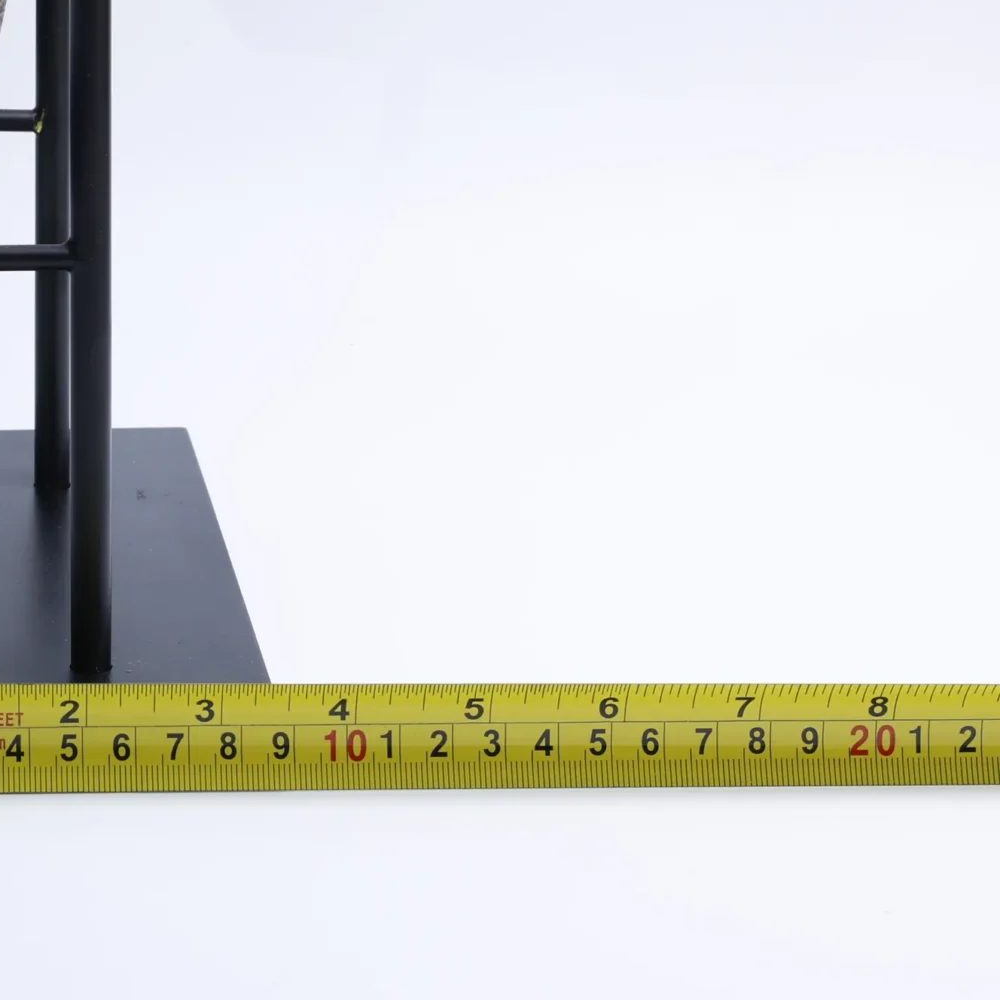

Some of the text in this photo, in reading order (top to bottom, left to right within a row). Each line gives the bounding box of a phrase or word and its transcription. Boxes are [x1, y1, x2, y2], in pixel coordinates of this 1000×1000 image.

[59, 700, 80, 724] 2
[195, 699, 215, 722] 3
[328, 698, 350, 721] 4
[464, 698, 484, 720] 5
[599, 697, 619, 718] 6
[735, 697, 755, 718] 7
[868, 696, 889, 717] 8
[5, 734, 24, 762] 4
[60, 734, 78, 762] 5
[112, 733, 131, 761] 6
[166, 733, 184, 761] 7
[219, 732, 237, 760] 8
[272, 731, 290, 760] 9
[324, 730, 367, 762] 10
[380, 730, 393, 759] 1
[429, 730, 448, 758] 2
[483, 729, 501, 757] 3
[534, 729, 554, 757] 4
[589, 729, 607, 756] 5
[641, 728, 660, 756] 6
[695, 728, 713, 755] 7
[748, 727, 766, 755] 8
[801, 727, 819, 754] 9
[849, 725, 896, 757] 20
[909, 725, 922, 754] 1
[958, 725, 977, 753] 2
